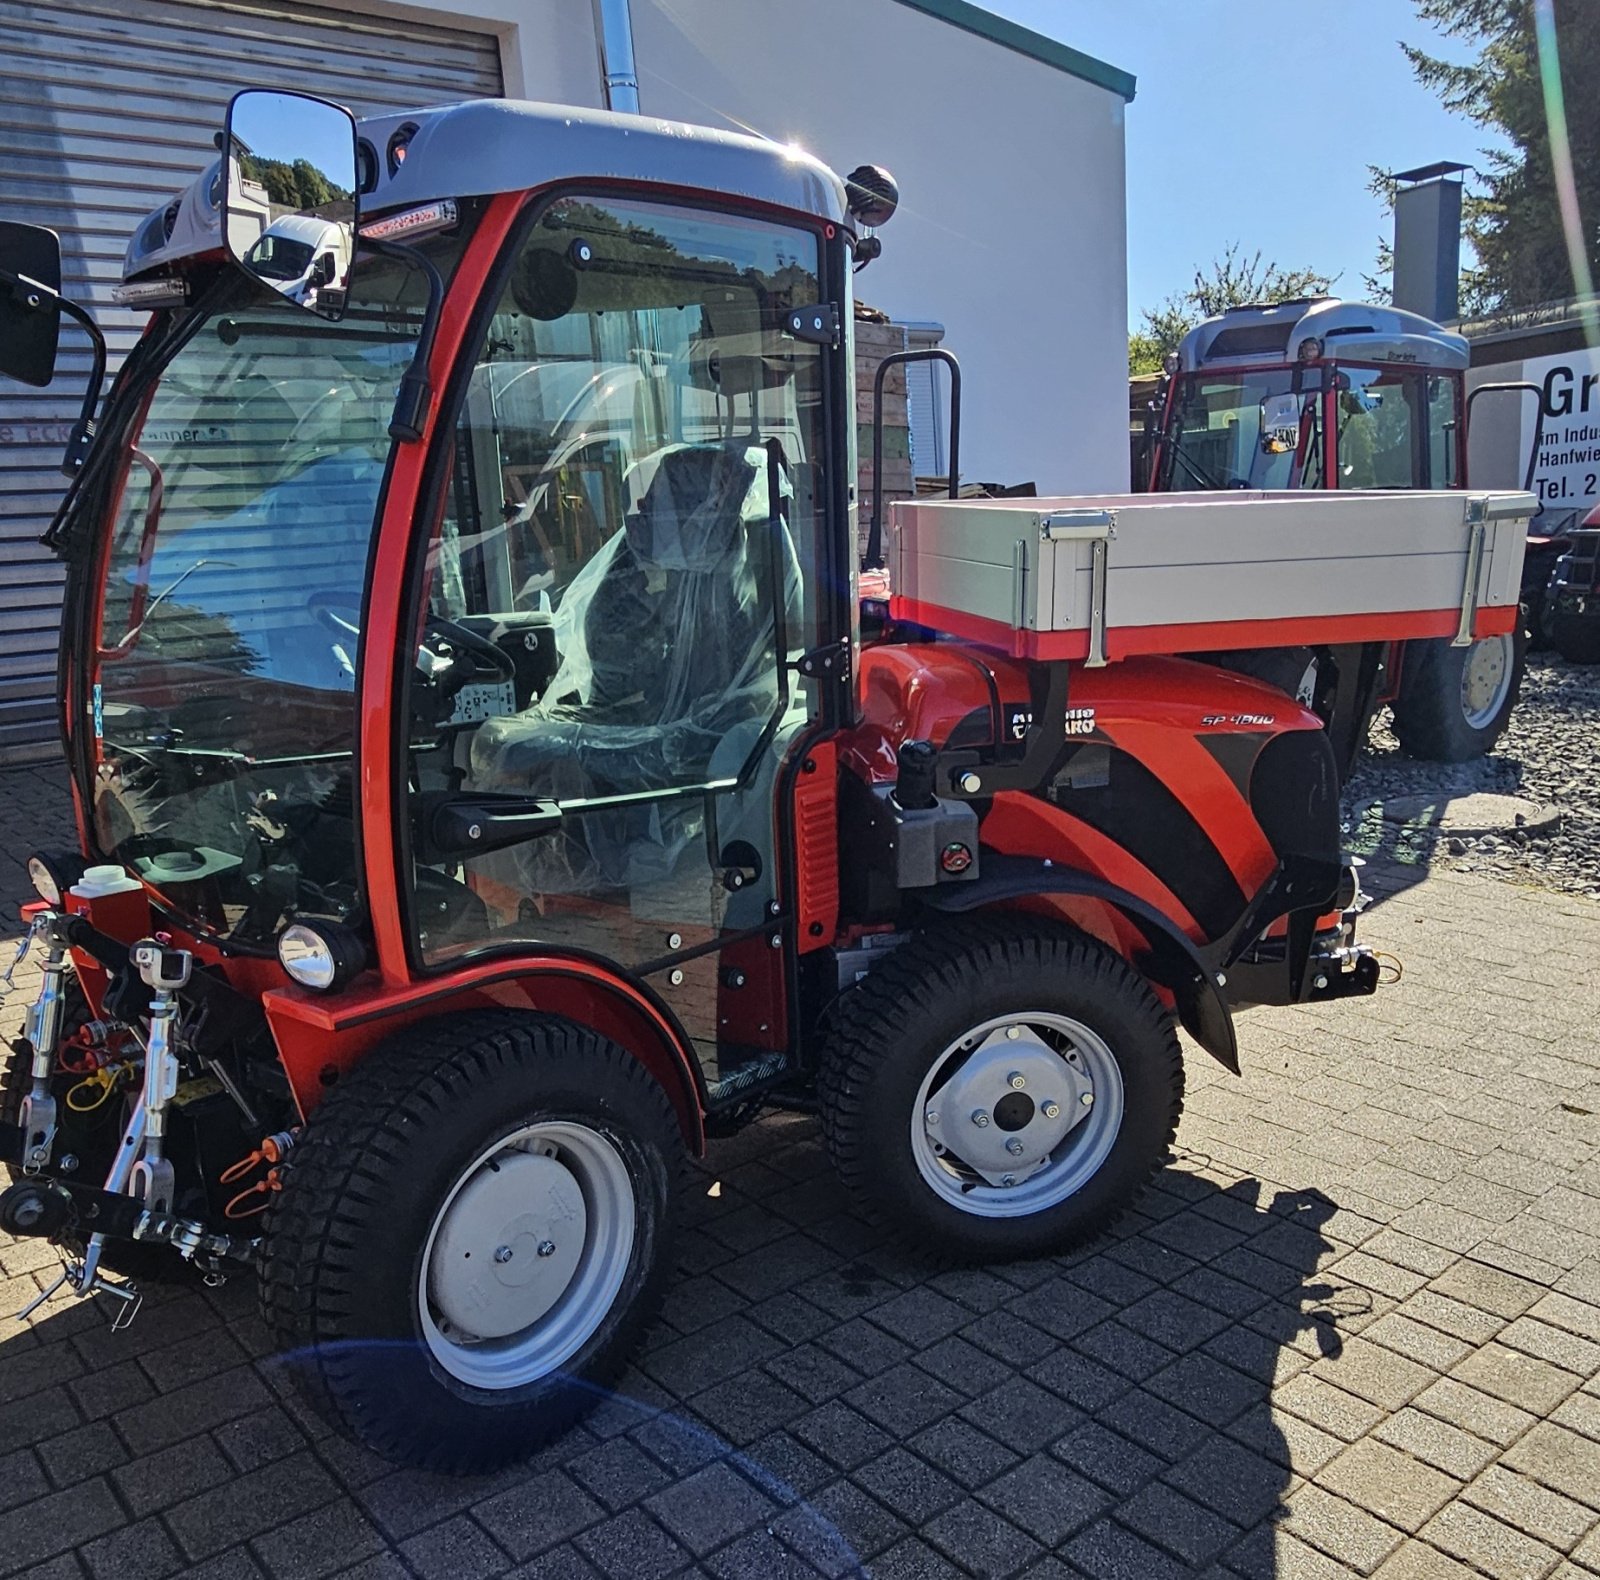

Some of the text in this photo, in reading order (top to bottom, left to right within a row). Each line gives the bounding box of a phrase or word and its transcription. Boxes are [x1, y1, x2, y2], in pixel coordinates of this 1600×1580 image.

[1540, 425, 1600, 447] im Indu
[1536, 473, 1598, 501] Tel. 2
